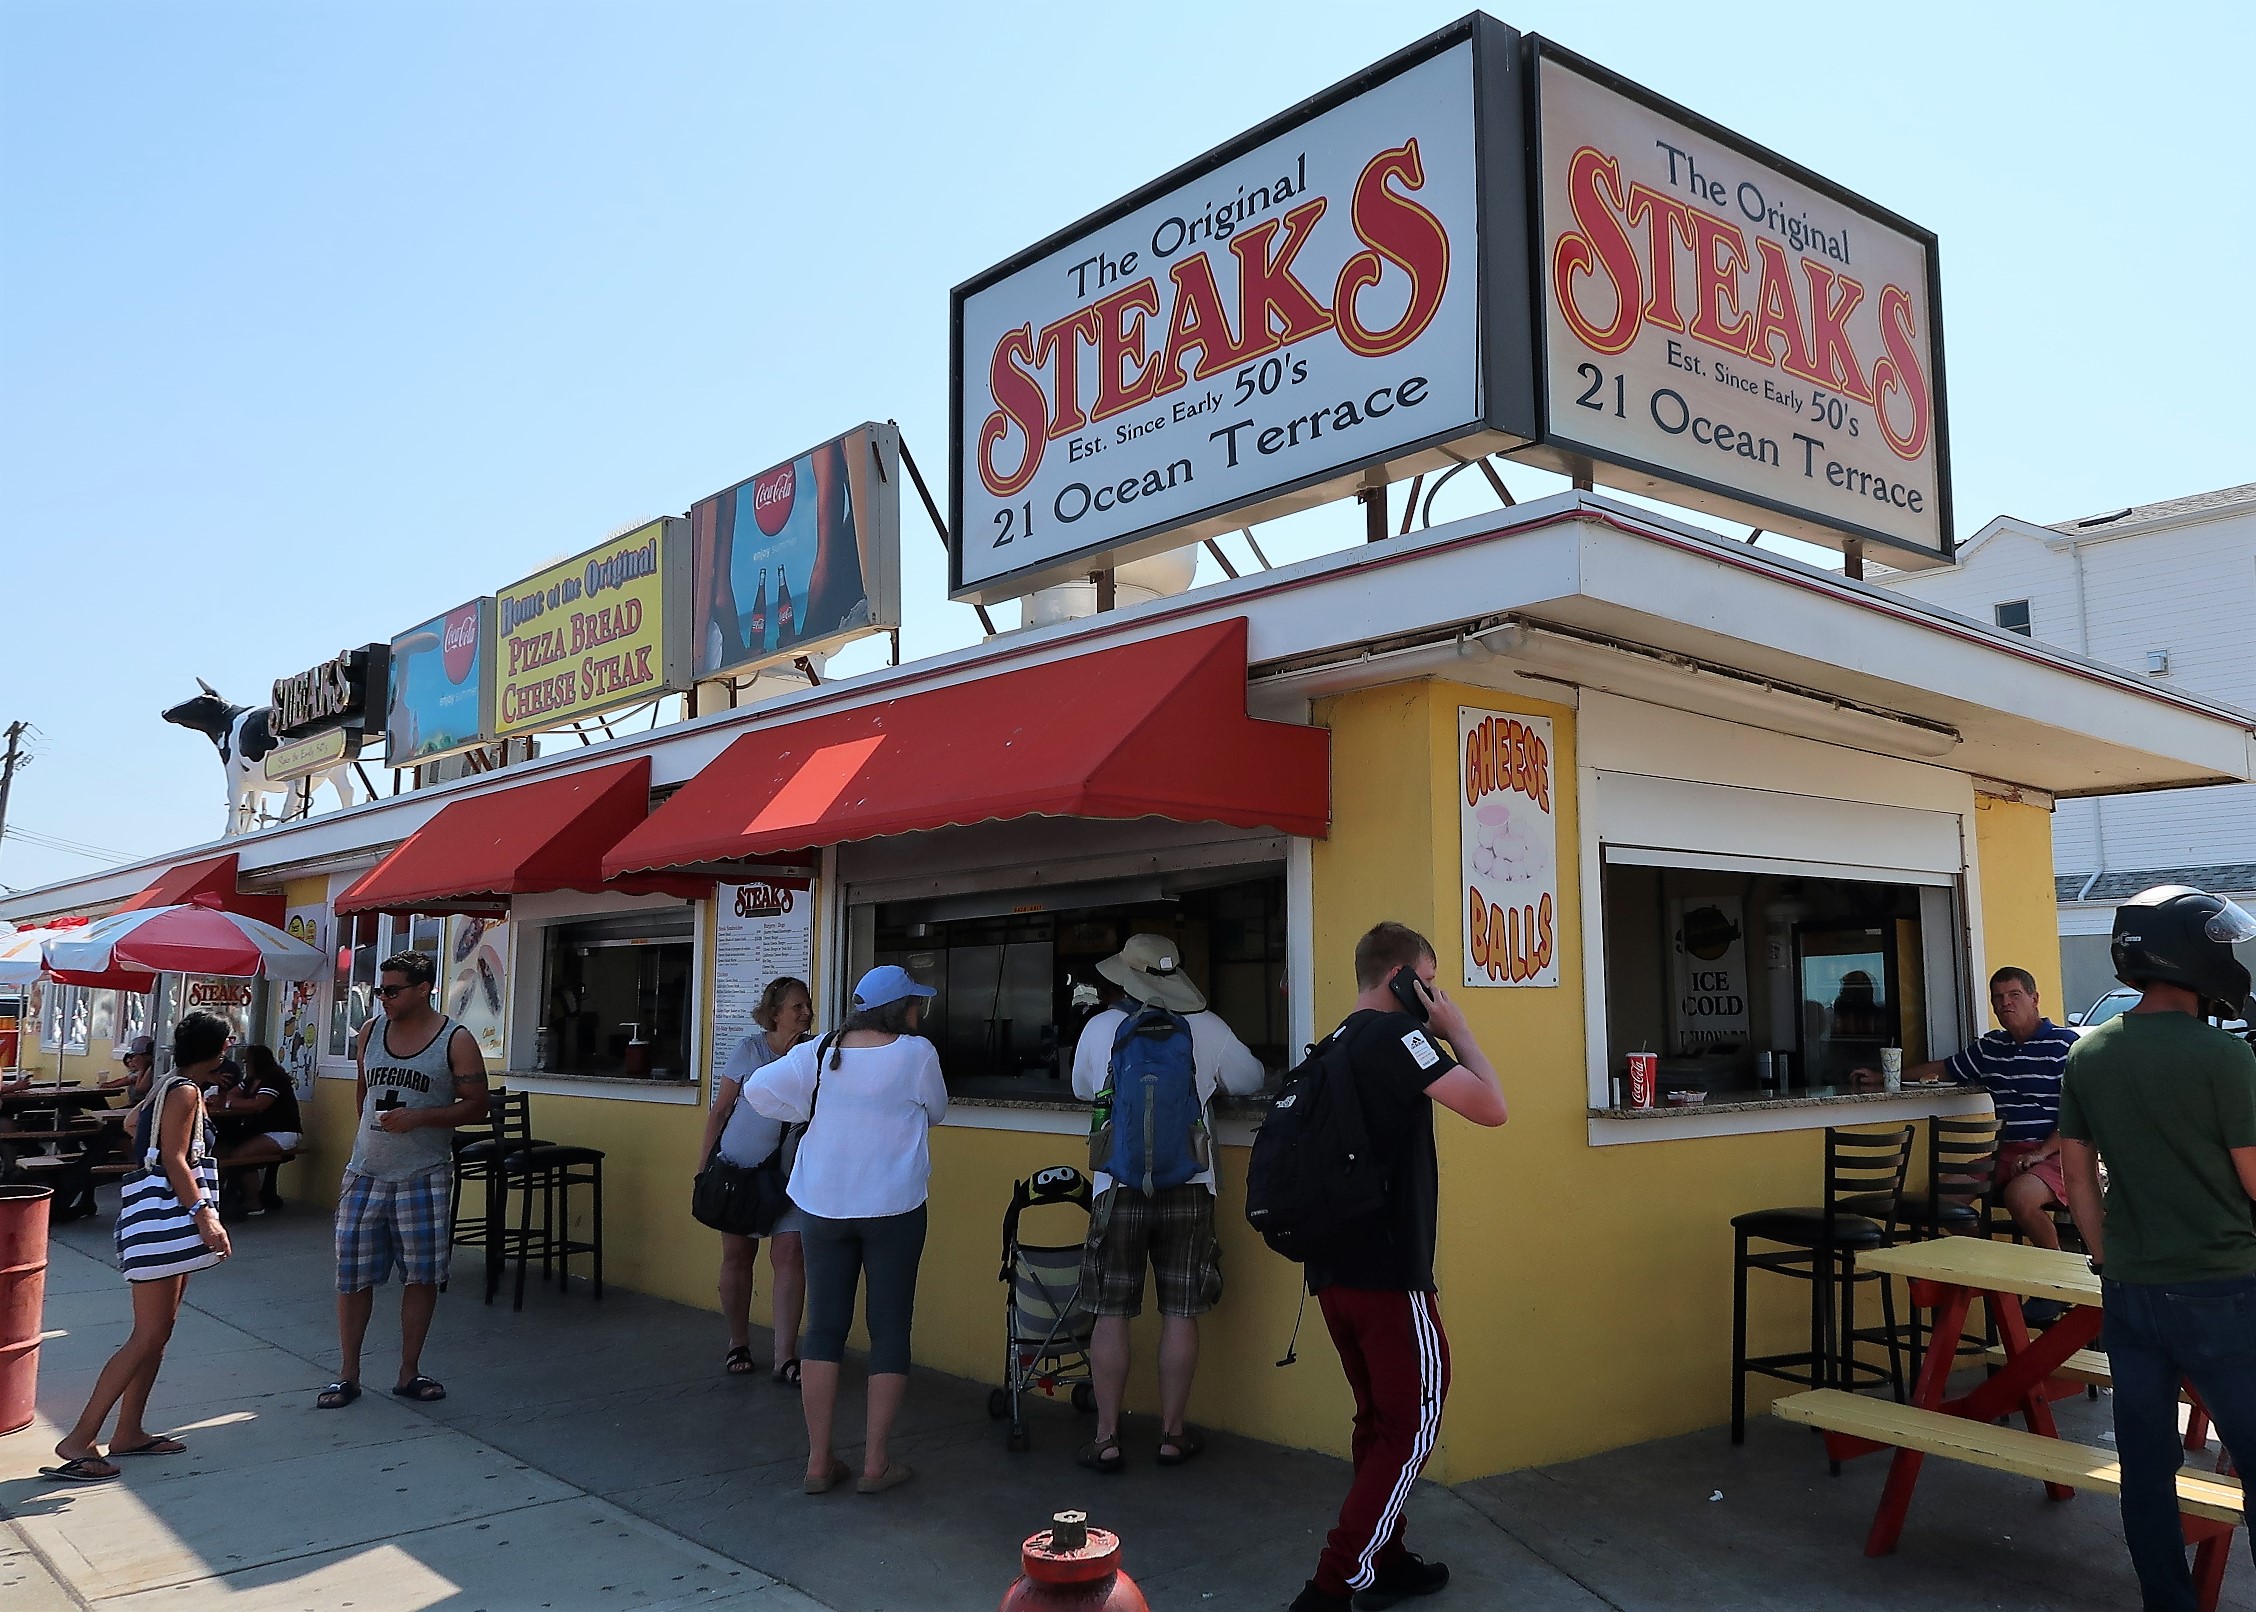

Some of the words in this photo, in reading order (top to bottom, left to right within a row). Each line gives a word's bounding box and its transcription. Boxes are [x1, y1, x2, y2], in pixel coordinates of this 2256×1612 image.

[1067, 251, 1139, 298] The
[1151, 152, 1308, 258] Original
[1656, 140, 1726, 206] The
[1737, 182, 1851, 265] Original
[977, 137, 1451, 498] STEAKS
[1553, 145, 1929, 461] STEAKS
[1068, 438, 1107, 464] Est.
[1115, 418, 1166, 445] Since
[1172, 390, 1223, 424] Early
[1234, 352, 1308, 407] 50's
[1667, 340, 1706, 377] Est.
[1714, 362, 1758, 396] Since
[1764, 379, 1803, 412] Early
[1810, 390, 1859, 437] 50's
[991, 500, 1033, 549] 21
[1053, 457, 1194, 524] Ocean
[1208, 376, 1429, 469] Terrace
[1576, 362, 1627, 419] 21
[1650, 388, 1780, 468] Ocean
[1792, 432, 1924, 514] Terrace
[501, 590, 545, 640] Home
[562, 577, 581, 605] the
[584, 537, 657, 599] Original
[502, 670, 576, 724] CHEESE
[580, 645, 654, 701] STEAK
[508, 627, 567, 677] PIZZA
[570, 598, 643, 656] BREAD
[268, 650, 352, 738] STEAKS
[1466, 715, 1550, 814] CHEESE
[735, 885, 793, 917] STEAKS
[1469, 886, 1553, 983] BALLS
[189, 982, 252, 1006] STEAKS
[1682, 995, 1744, 1016] COLD
[1692, 971, 1730, 992] ICE
[366, 1067, 431, 1093] LIFEGUARD
